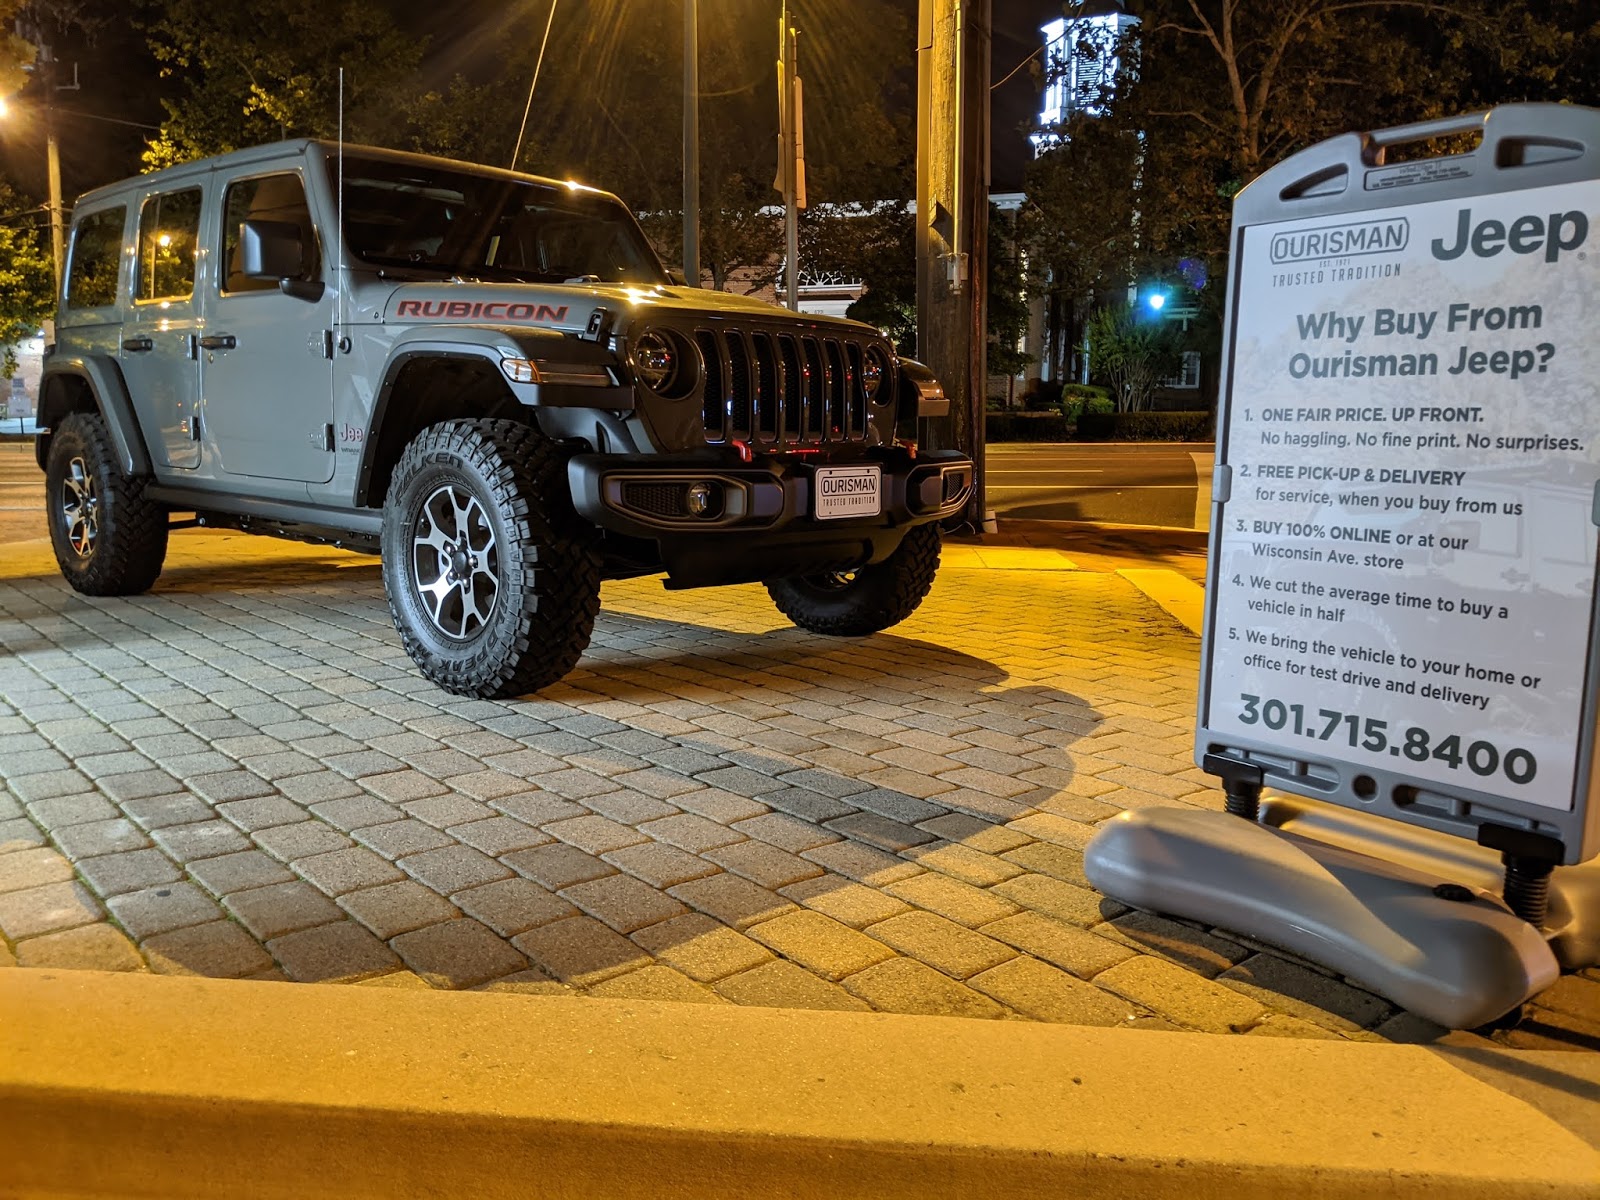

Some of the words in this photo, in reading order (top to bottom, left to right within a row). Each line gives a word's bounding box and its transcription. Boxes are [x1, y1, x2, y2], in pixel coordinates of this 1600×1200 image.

[1274, 224, 1404, 260] OURISMAN
[1431, 208, 1589, 263] Jeep
[1273, 270, 1324, 287] TRUSTED
[1331, 263, 1401, 282] TRADITION
[396, 300, 570, 322] RUBICON
[1297, 311, 1365, 342] Why
[1374, 308, 1437, 340] Buy
[1448, 303, 1543, 332] From
[1289, 350, 1438, 379] Ourisman
[1448, 343, 1556, 379] Jeep?
[1244, 409, 1253, 421] 1.
[1262, 408, 1294, 422] ONE
[1297, 408, 1331, 422] FAIR
[1335, 408, 1387, 422] PRICE.
[1392, 407, 1415, 422] UP
[1419, 407, 1484, 423] FRONT.
[340, 423, 364, 442] Jee
[1261, 432, 1281, 445] No
[1284, 432, 1351, 448] haggling.
[1356, 433, 1378, 447] No
[1382, 433, 1411, 447] fine
[1416, 433, 1460, 450] print.
[1466, 434, 1491, 449] No
[1495, 435, 1584, 452] surprises.
[823, 479, 875, 493] OURISMAN
[1240, 465, 1252, 477] 2.
[1257, 466, 1294, 479] FREE
[1298, 467, 1360, 482] PICK-UP
[1364, 469, 1374, 482] &
[1379, 469, 1466, 486] DELIVERY
[823, 498, 846, 506] TRUSTED
[1255, 487, 1275, 501] for
[1279, 489, 1333, 506] service,
[1338, 492, 1379, 508] when
[1384, 496, 1414, 511] you
[1419, 496, 1450, 514] buy
[1455, 497, 1496, 515] from
[1503, 503, 1523, 516] us
[1236, 520, 1248, 533] 3.
[1253, 521, 1283, 535] BUY
[1286, 523, 1326, 539] 100%
[1330, 526, 1391, 544] ONLINE
[1396, 533, 1413, 545] or
[1418, 533, 1434, 547] at
[1439, 536, 1469, 550] our
[1252, 542, 1322, 562] Wisconsin
[1327, 549, 1359, 565] Ave.
[1364, 554, 1404, 570] store
[1232, 575, 1245, 587] 4.
[1250, 576, 1271, 590] We
[1275, 579, 1297, 593] cut
[1301, 581, 1325, 596] the
[1329, 586, 1390, 605] average
[1395, 592, 1432, 609] time
[1437, 598, 1455, 612] to
[1460, 600, 1493, 619] buy
[1498, 607, 1508, 619] a
[1248, 599, 1295, 616] vehicle
[1300, 604, 1312, 618] in
[1316, 607, 1345, 623] half
[1228, 628, 1240, 641] 5.
[1246, 630, 1267, 645] We
[1271, 633, 1308, 653] bring
[1312, 640, 1336, 656] the
[1340, 645, 1395, 665] vehicle
[1400, 654, 1417, 668] to
[1421, 658, 1460, 676] your
[1464, 663, 1515, 685] home
[1520, 674, 1541, 689] or
[1243, 653, 1282, 672] office
[1286, 660, 1307, 676] for
[1310, 664, 1338, 681] test
[1342, 669, 1381, 689] drive
[1385, 677, 1415, 695] and
[1420, 683, 1490, 710] delivery
[1238, 693, 1538, 785] 301.715.8400
